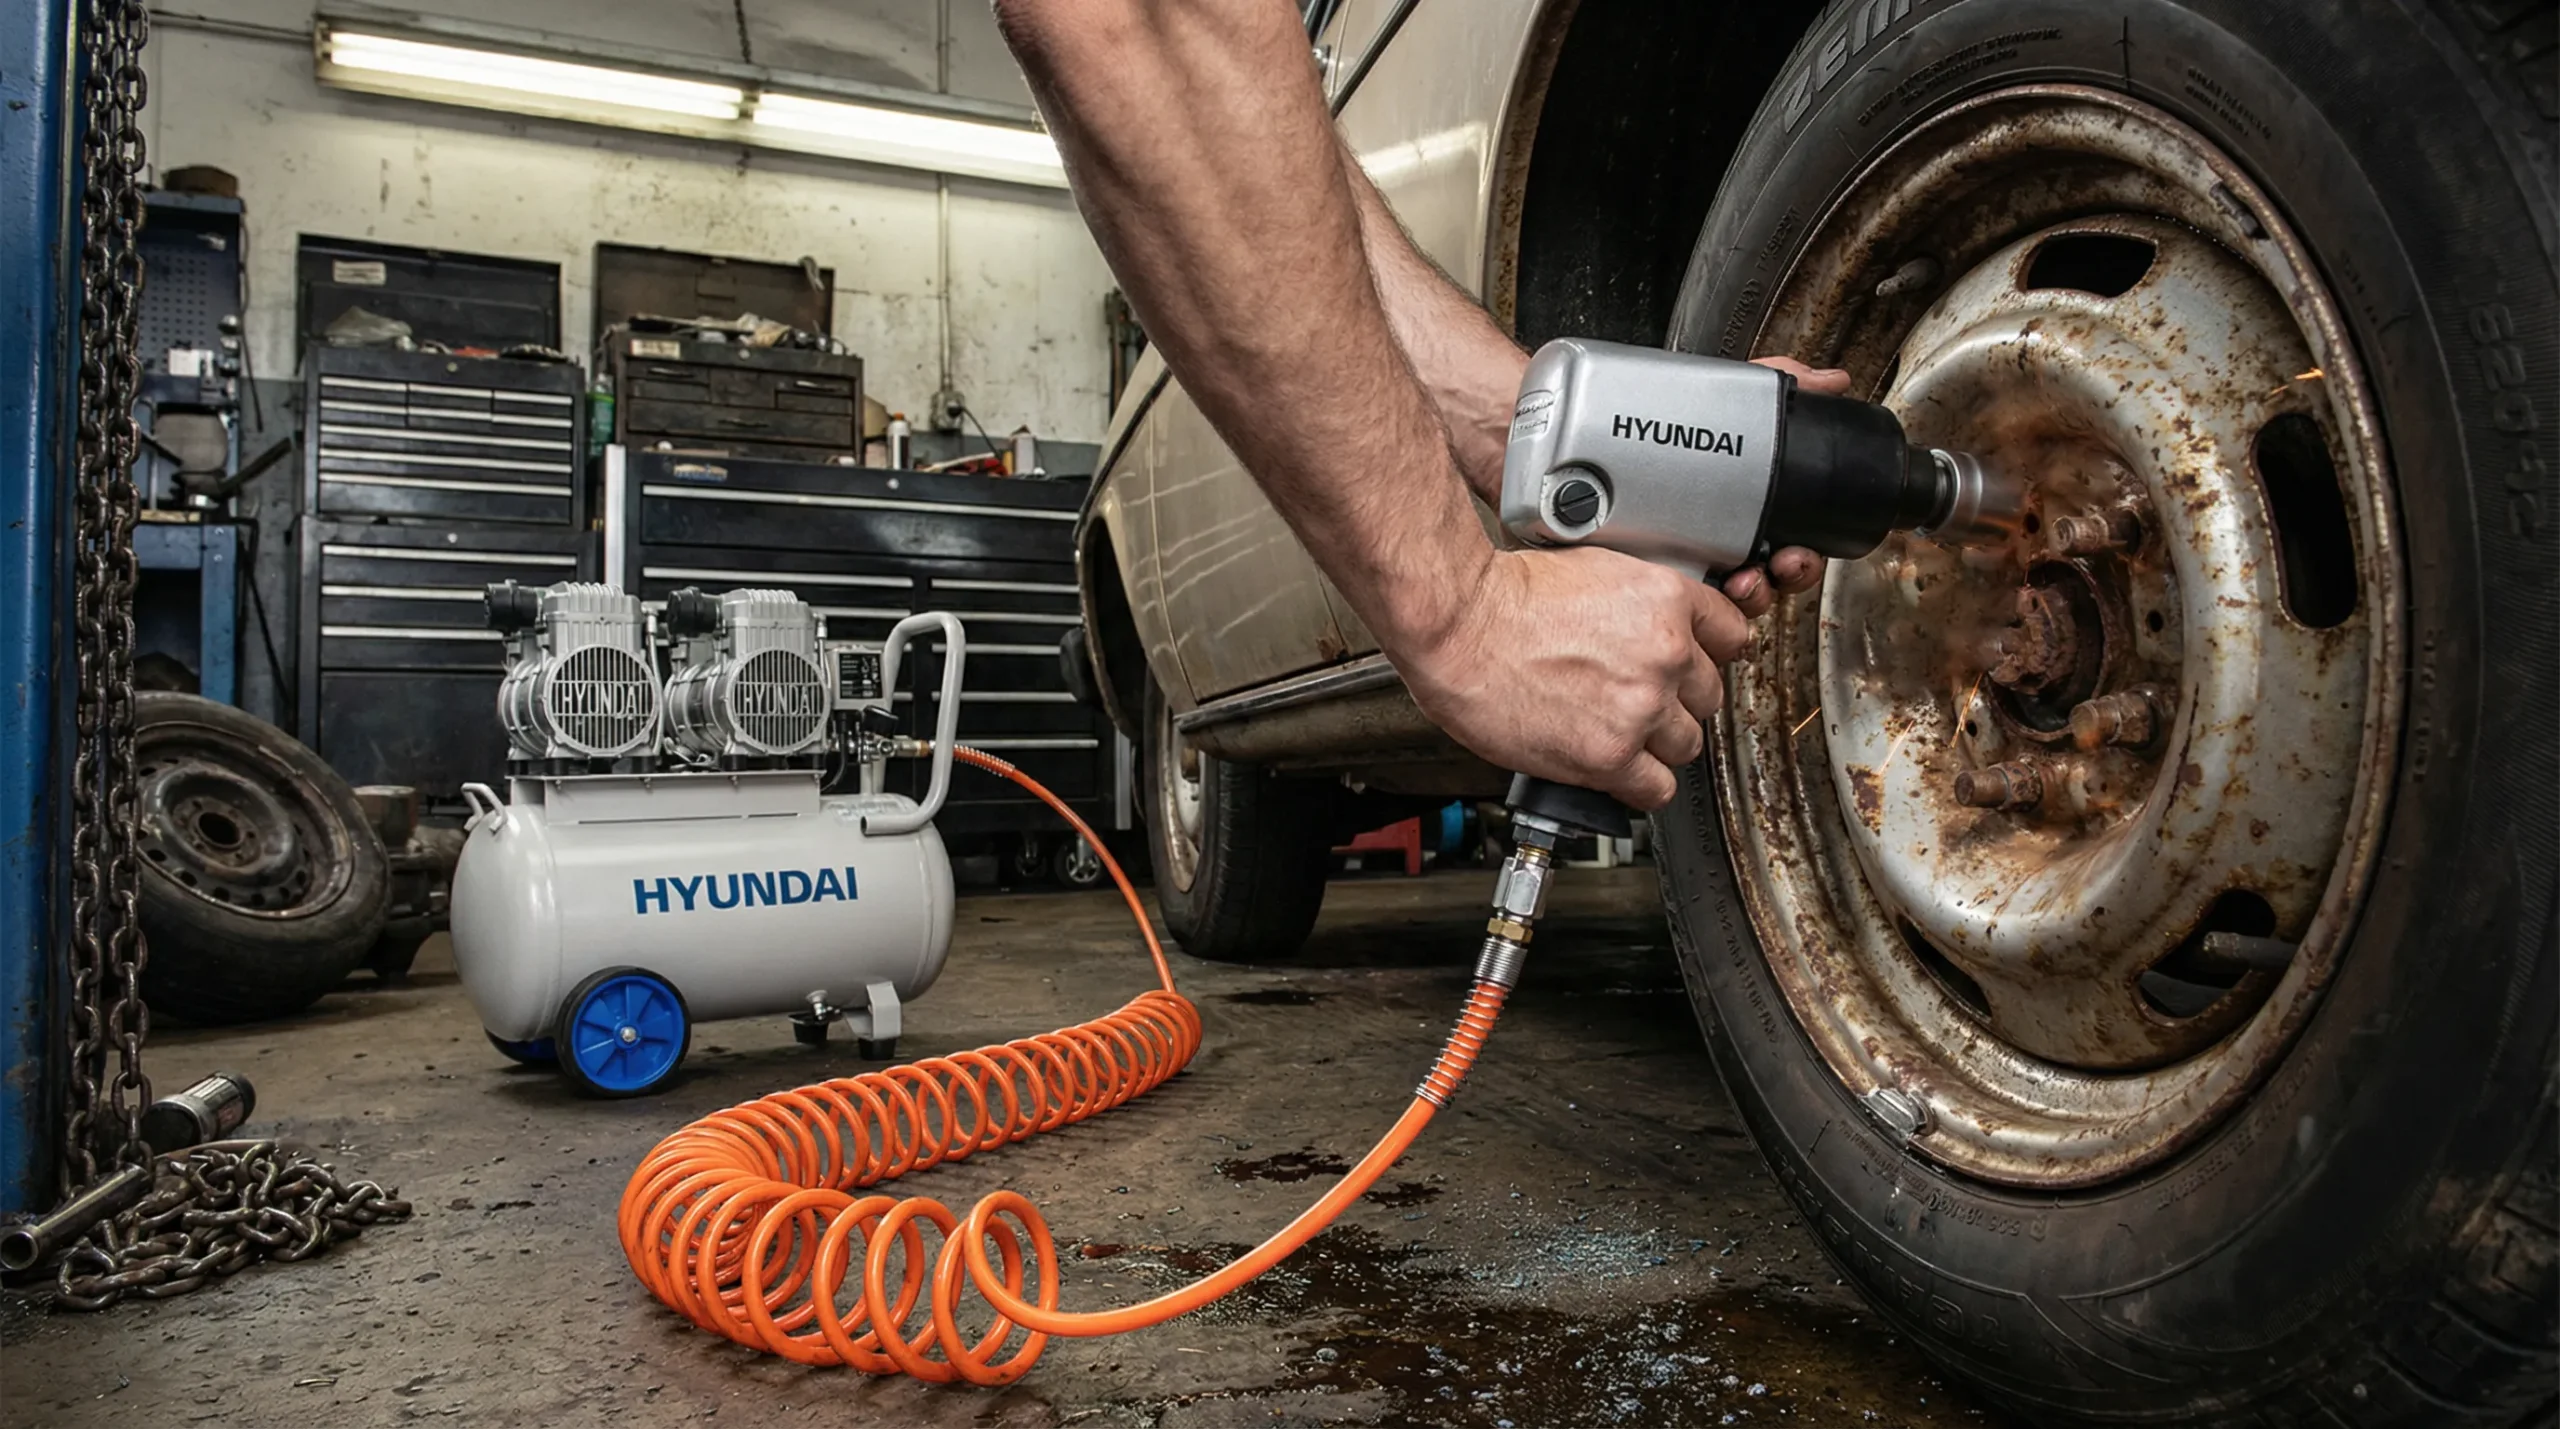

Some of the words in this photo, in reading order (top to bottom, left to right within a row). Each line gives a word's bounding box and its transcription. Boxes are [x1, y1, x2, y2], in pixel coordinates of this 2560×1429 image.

[1612, 414, 1743, 457] HYUNDAI
[562, 682, 643, 715] HYUNDAI
[633, 867, 858, 914] HYUNDAI
